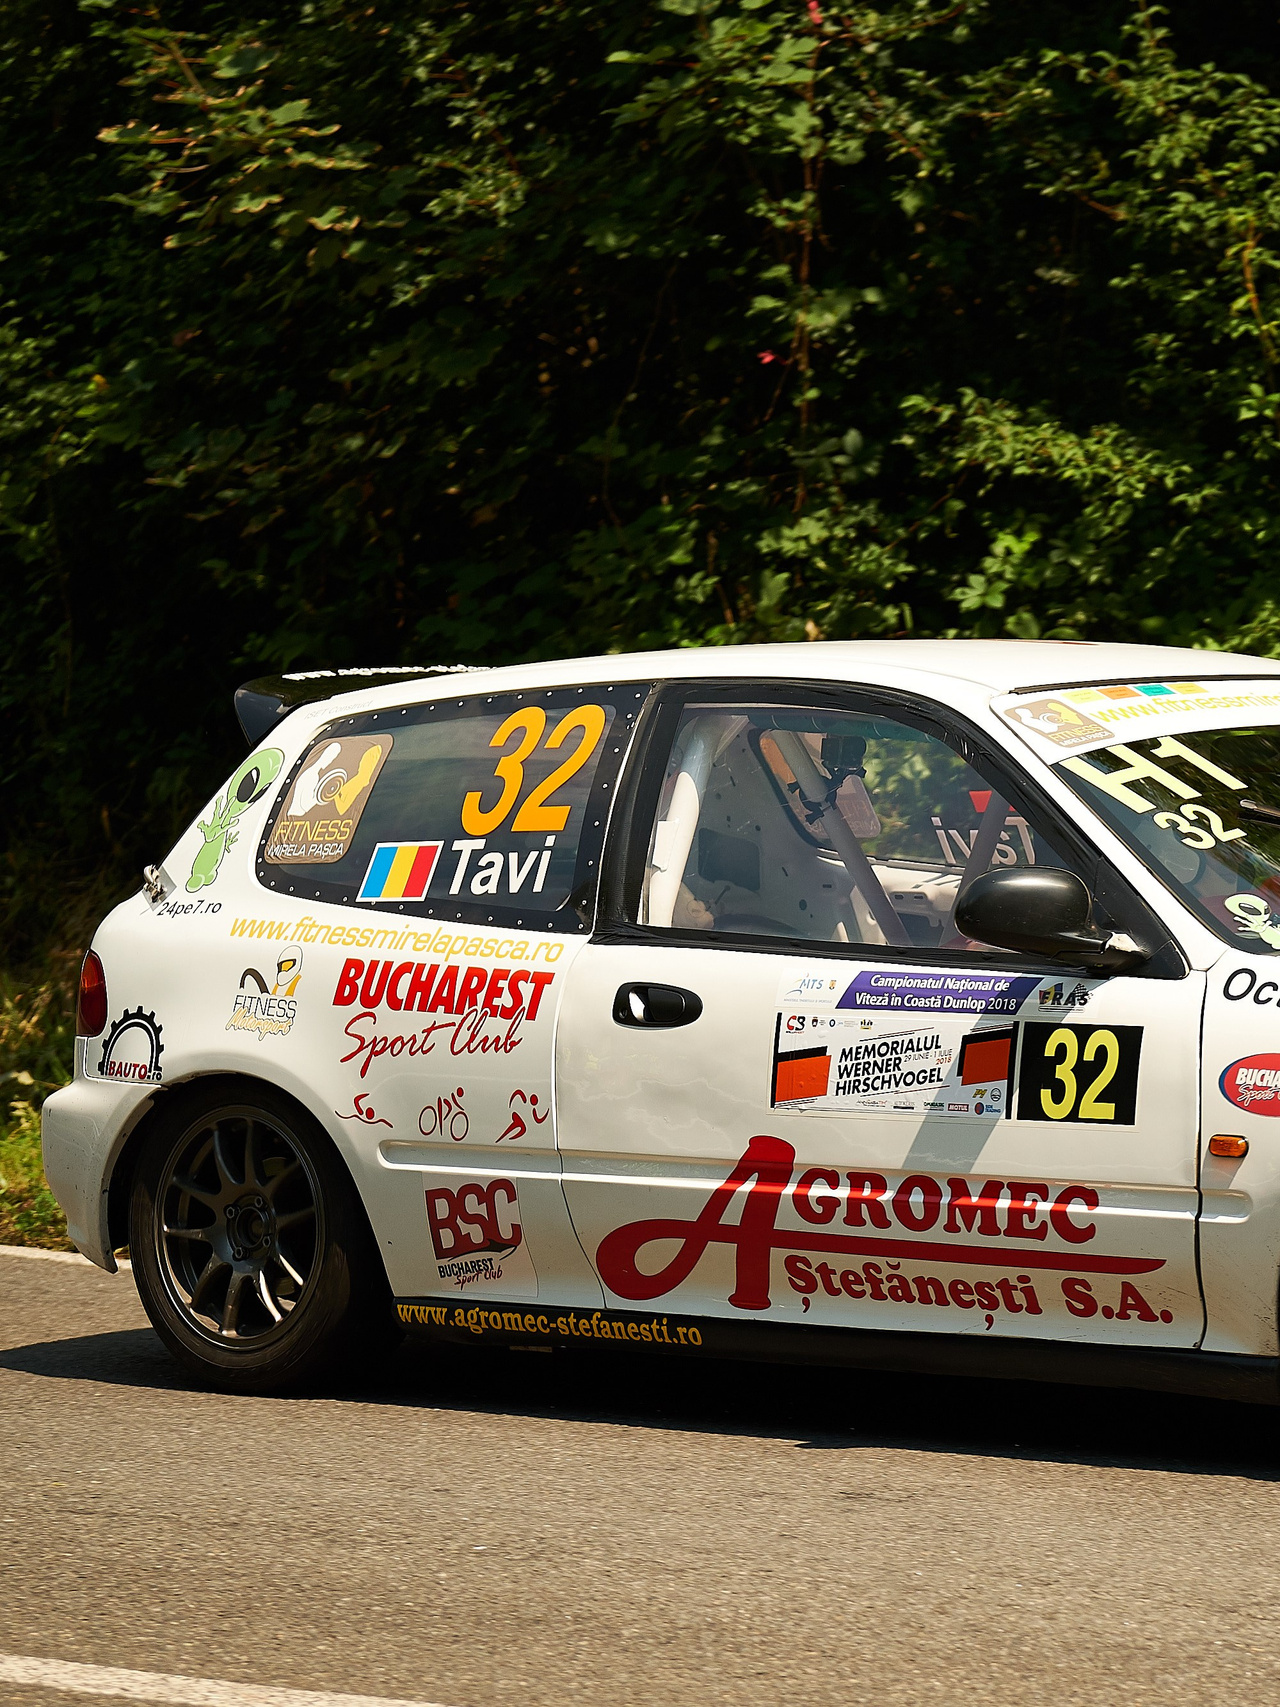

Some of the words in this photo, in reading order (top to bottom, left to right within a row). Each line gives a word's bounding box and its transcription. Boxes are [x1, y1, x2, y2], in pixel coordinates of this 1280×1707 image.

[461, 705, 606, 836] 32
[275, 819, 353, 842] FITNESS
[1153, 803, 1247, 850] 32
[266, 844, 306, 857] MIRELA
[449, 834, 553, 896] Tavi
[156, 899, 222, 921] 24pe7.ro
[229, 916, 564, 963] www.fitnessmirelapasca.ro
[333, 958, 555, 1021] BUCHAREST
[870, 974, 944, 991] Campionatul
[994, 978, 1011, 992] de
[233, 994, 298, 1019] FITNESS
[855, 992, 889, 1006] Viteză
[890, 993, 902, 1006] în
[903, 994, 942, 1008] Coastă
[943, 996, 986, 1012] Dunlop
[987, 998, 1017, 1011] 2018
[225, 1007, 294, 1041] Motorsport
[340, 1011, 451, 1077] Sport
[450, 1007, 524, 1056] Club
[839, 1034, 942, 1063] MEMORIALUL
[835, 1067, 944, 1096] HIRSCHVOGEL
[837, 1056, 903, 1080] WERNER
[1040, 1027, 1120, 1120] 32
[1237, 1083, 1276, 1104] Sport
[425, 1178, 523, 1260] BSC
[596, 1135, 1100, 1310] AGROMEC
[438, 1257, 494, 1279] BUCHAREST
[454, 1270, 482, 1291] Sport
[783, 1254, 1043, 1331] Ștefănești
[1062, 1277, 1175, 1325] S.A.
[396, 1303, 703, 1346] www.agromec-stefanesti.ro
